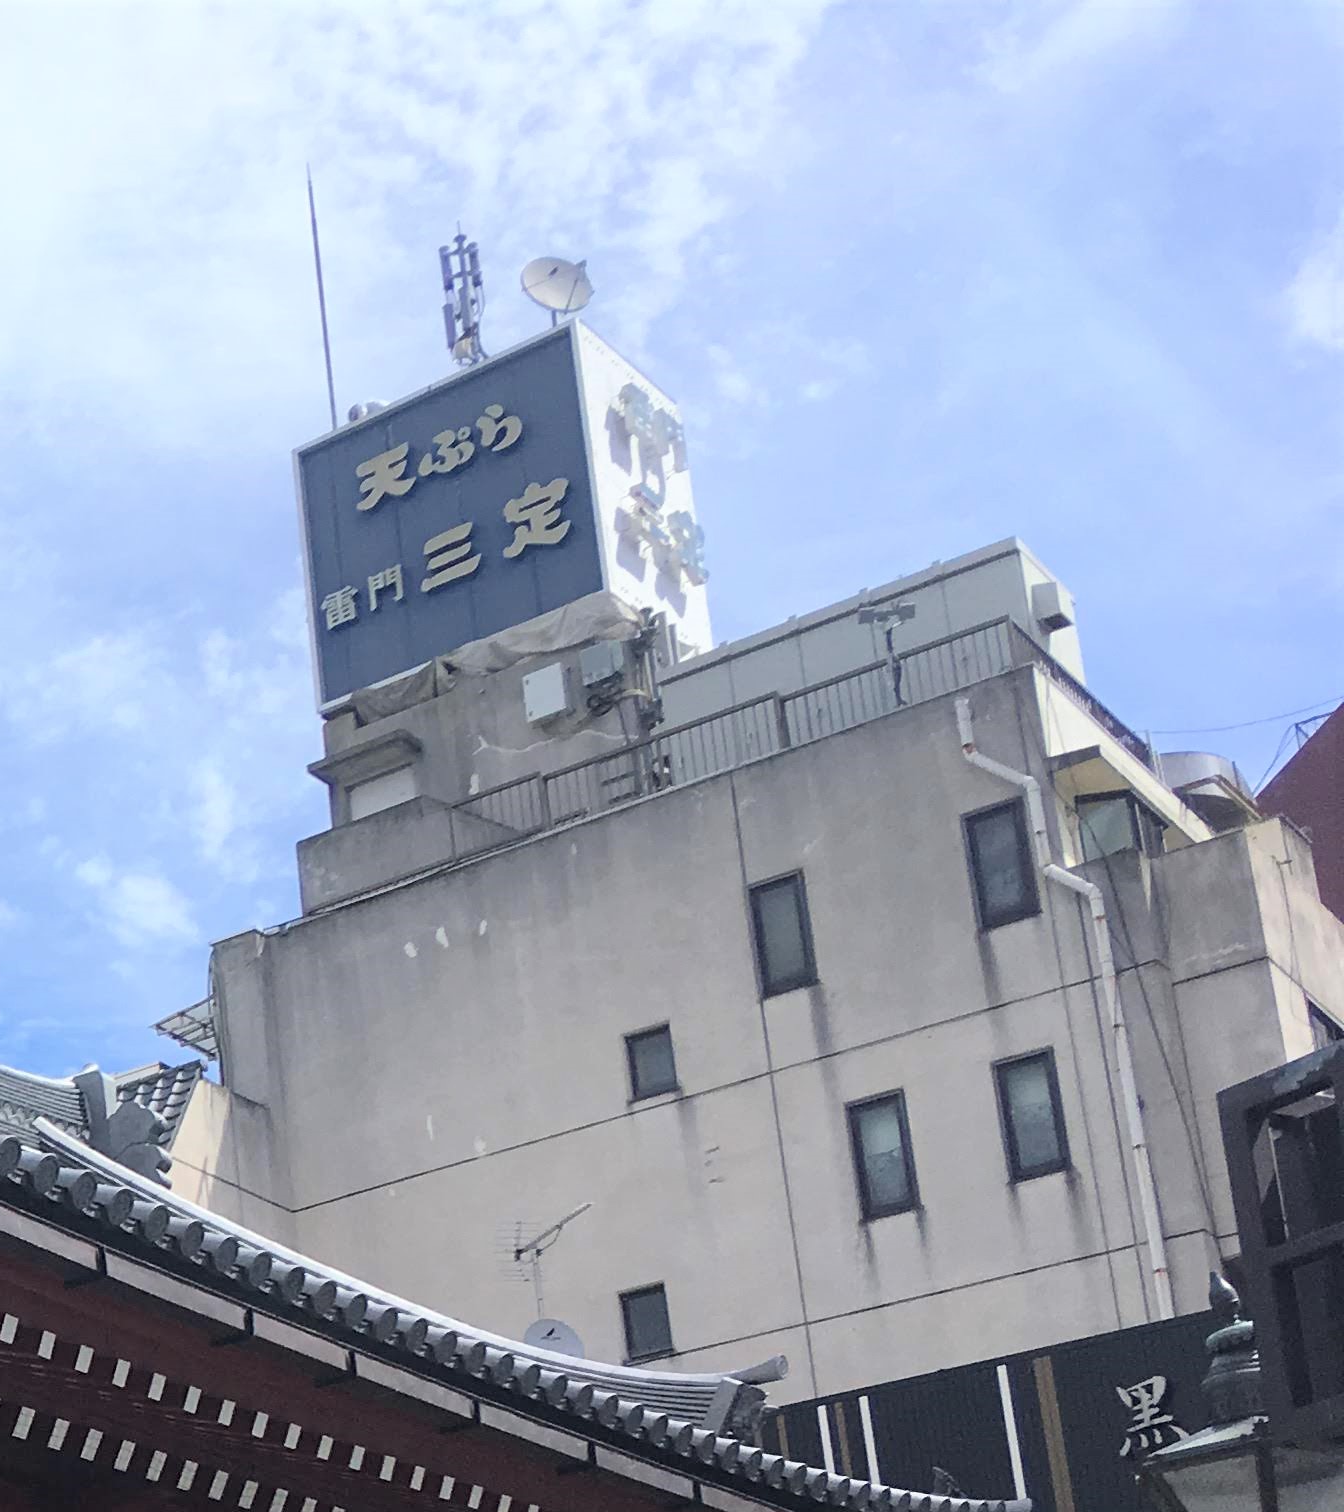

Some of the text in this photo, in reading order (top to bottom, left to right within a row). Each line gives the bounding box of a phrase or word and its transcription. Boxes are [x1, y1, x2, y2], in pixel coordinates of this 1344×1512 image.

[355, 404, 523, 512] 天ぷら
[320, 564, 405, 631] 雷門
[419, 477, 572, 593] 三定
